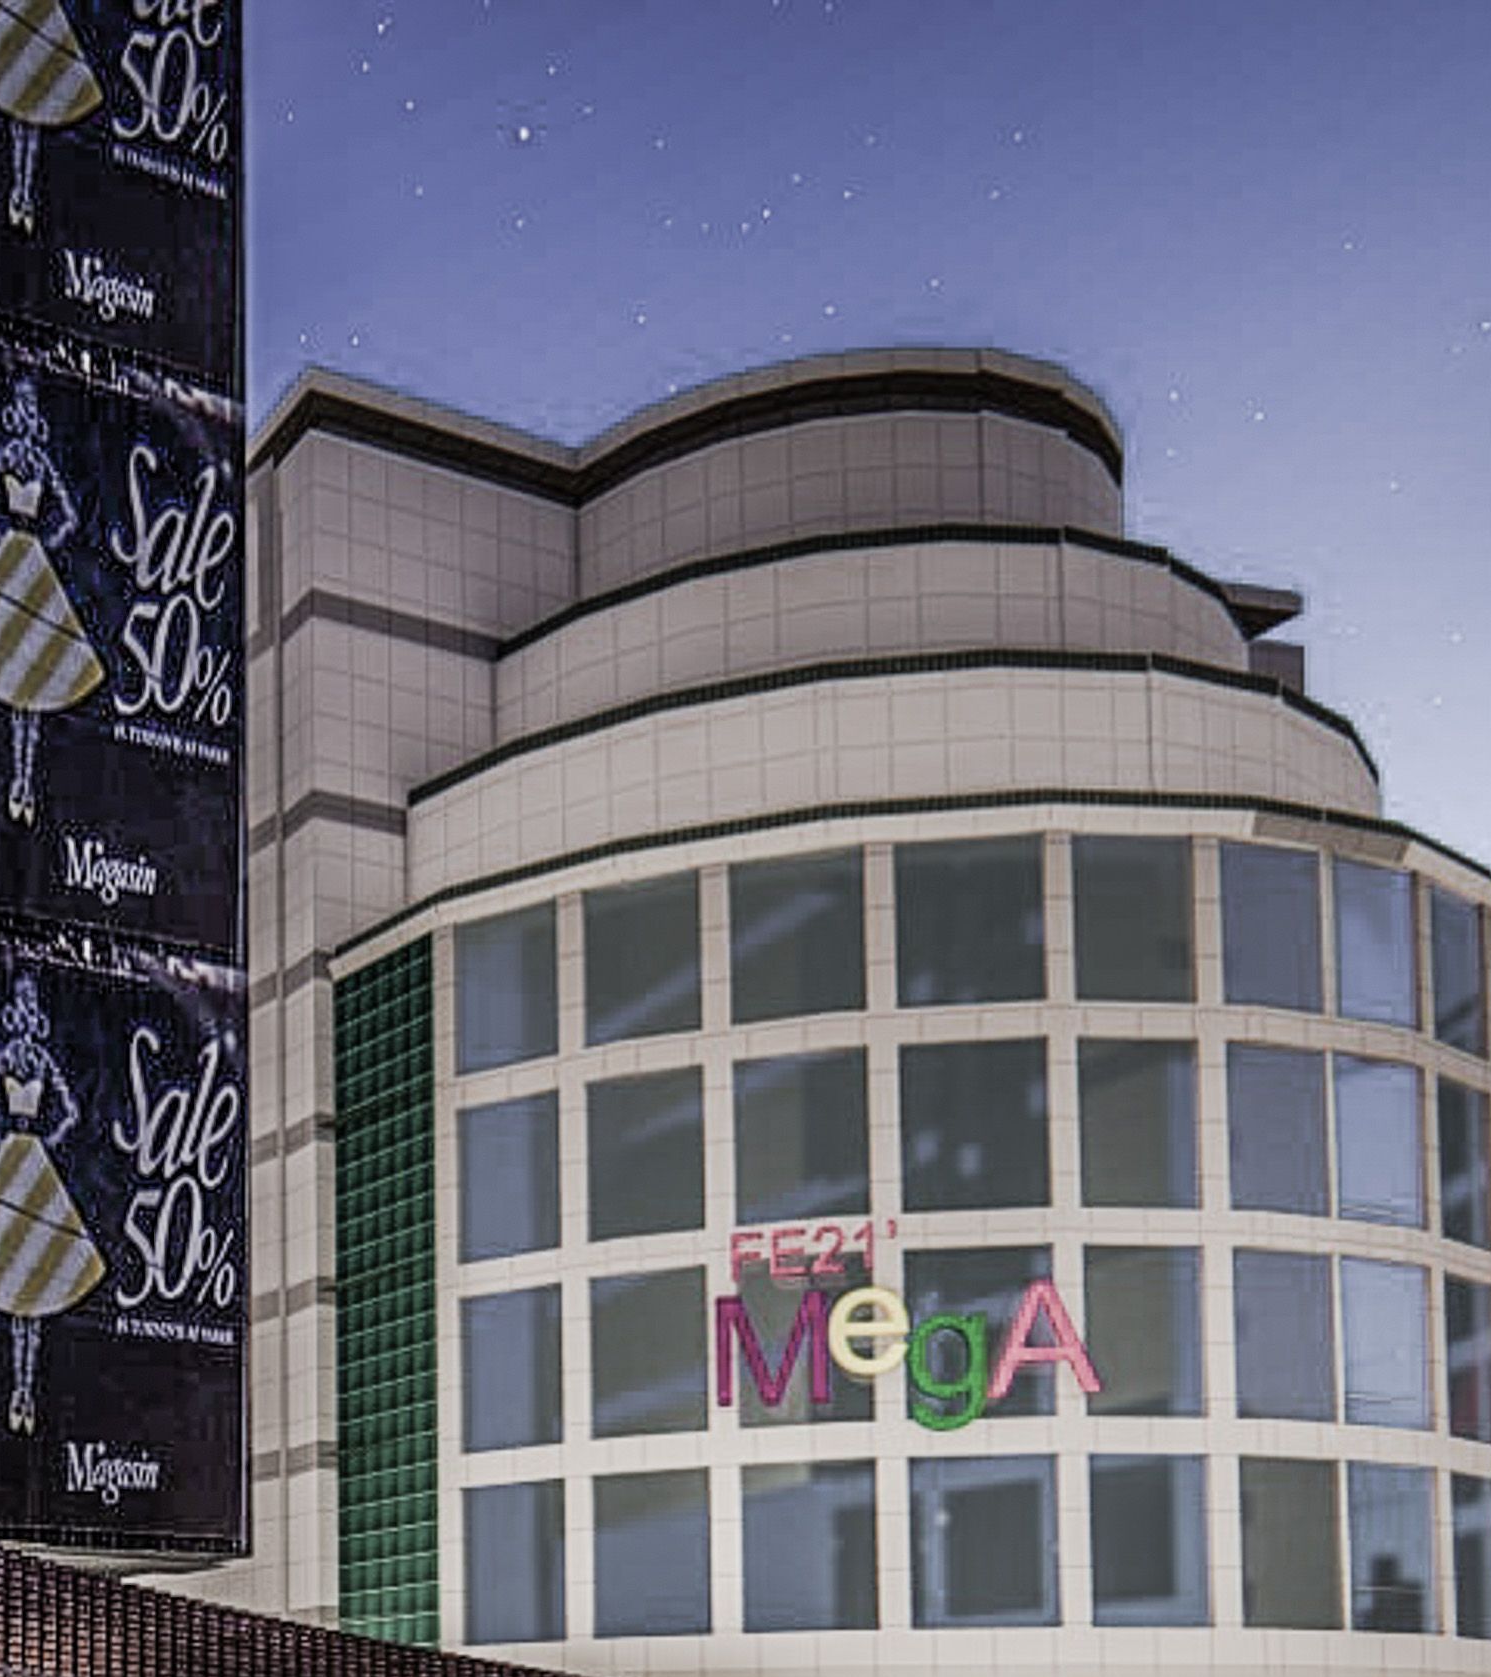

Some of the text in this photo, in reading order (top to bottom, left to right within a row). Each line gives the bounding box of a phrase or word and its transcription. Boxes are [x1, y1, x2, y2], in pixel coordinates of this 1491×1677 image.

[112, 28, 229, 161] 50%
[111, 446, 235, 611] Sale
[114, 593, 232, 726] 50%
[113, 1027, 240, 1188] Sale
[116, 1175, 236, 1307] 50%
[715, 1278, 1102, 1431] MegA
